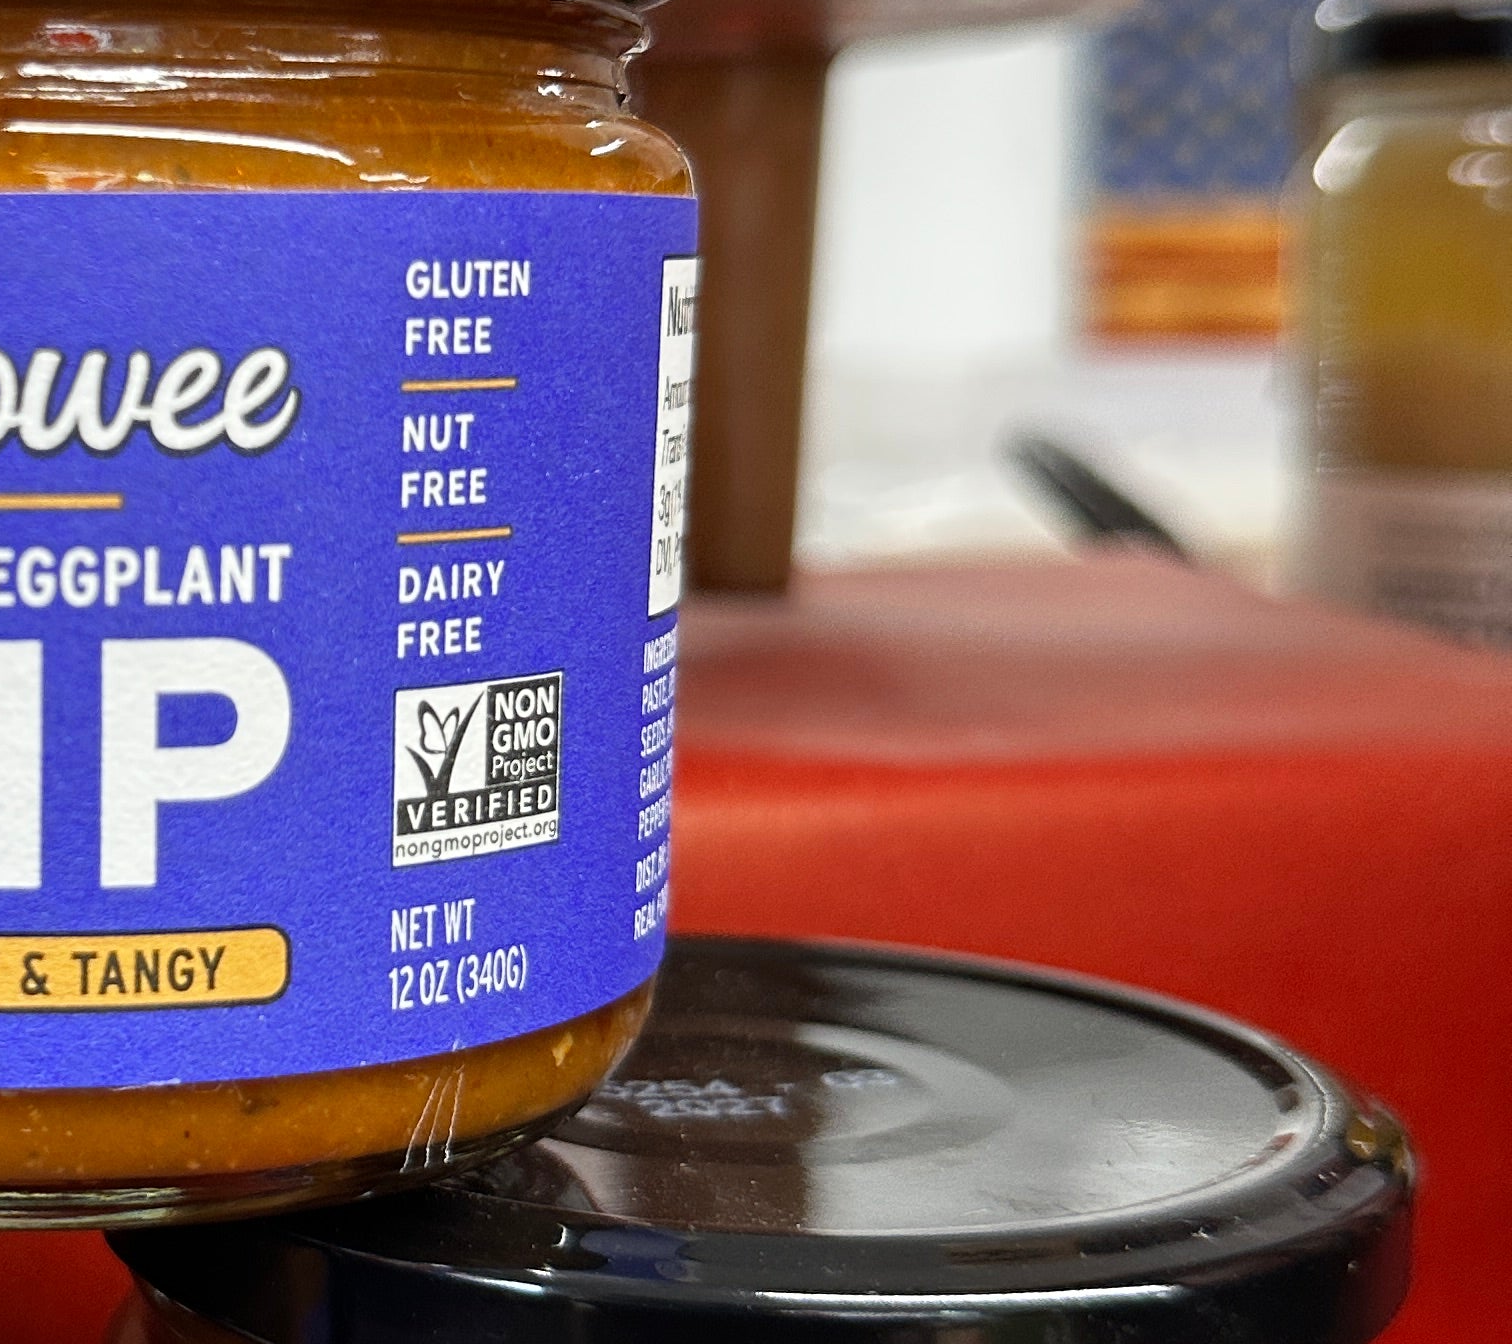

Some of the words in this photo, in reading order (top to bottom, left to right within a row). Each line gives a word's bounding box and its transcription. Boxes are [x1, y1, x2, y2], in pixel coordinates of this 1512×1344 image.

[405, 260, 531, 299] GLUTEN
[405, 317, 493, 355] FREE
[402, 413, 474, 452] NUT
[401, 468, 487, 508] FREE
[398, 560, 505, 603] DAIRY
[397, 617, 483, 658] FREE
[494, 685, 555, 721] NON
[492, 717, 555, 753] GMO
[491, 750, 553, 780] Project
[407, 784, 553, 830] VERIFIED
[395, 818, 557, 858] nongmoproject.org
[391, 904, 437, 953] NET
[443, 898, 476, 945] WT
[19, 953, 49, 995] &
[72, 946, 226, 994] TANGY
[419, 959, 450, 1006] OZ
[456, 944, 527, 1004] (340G)
